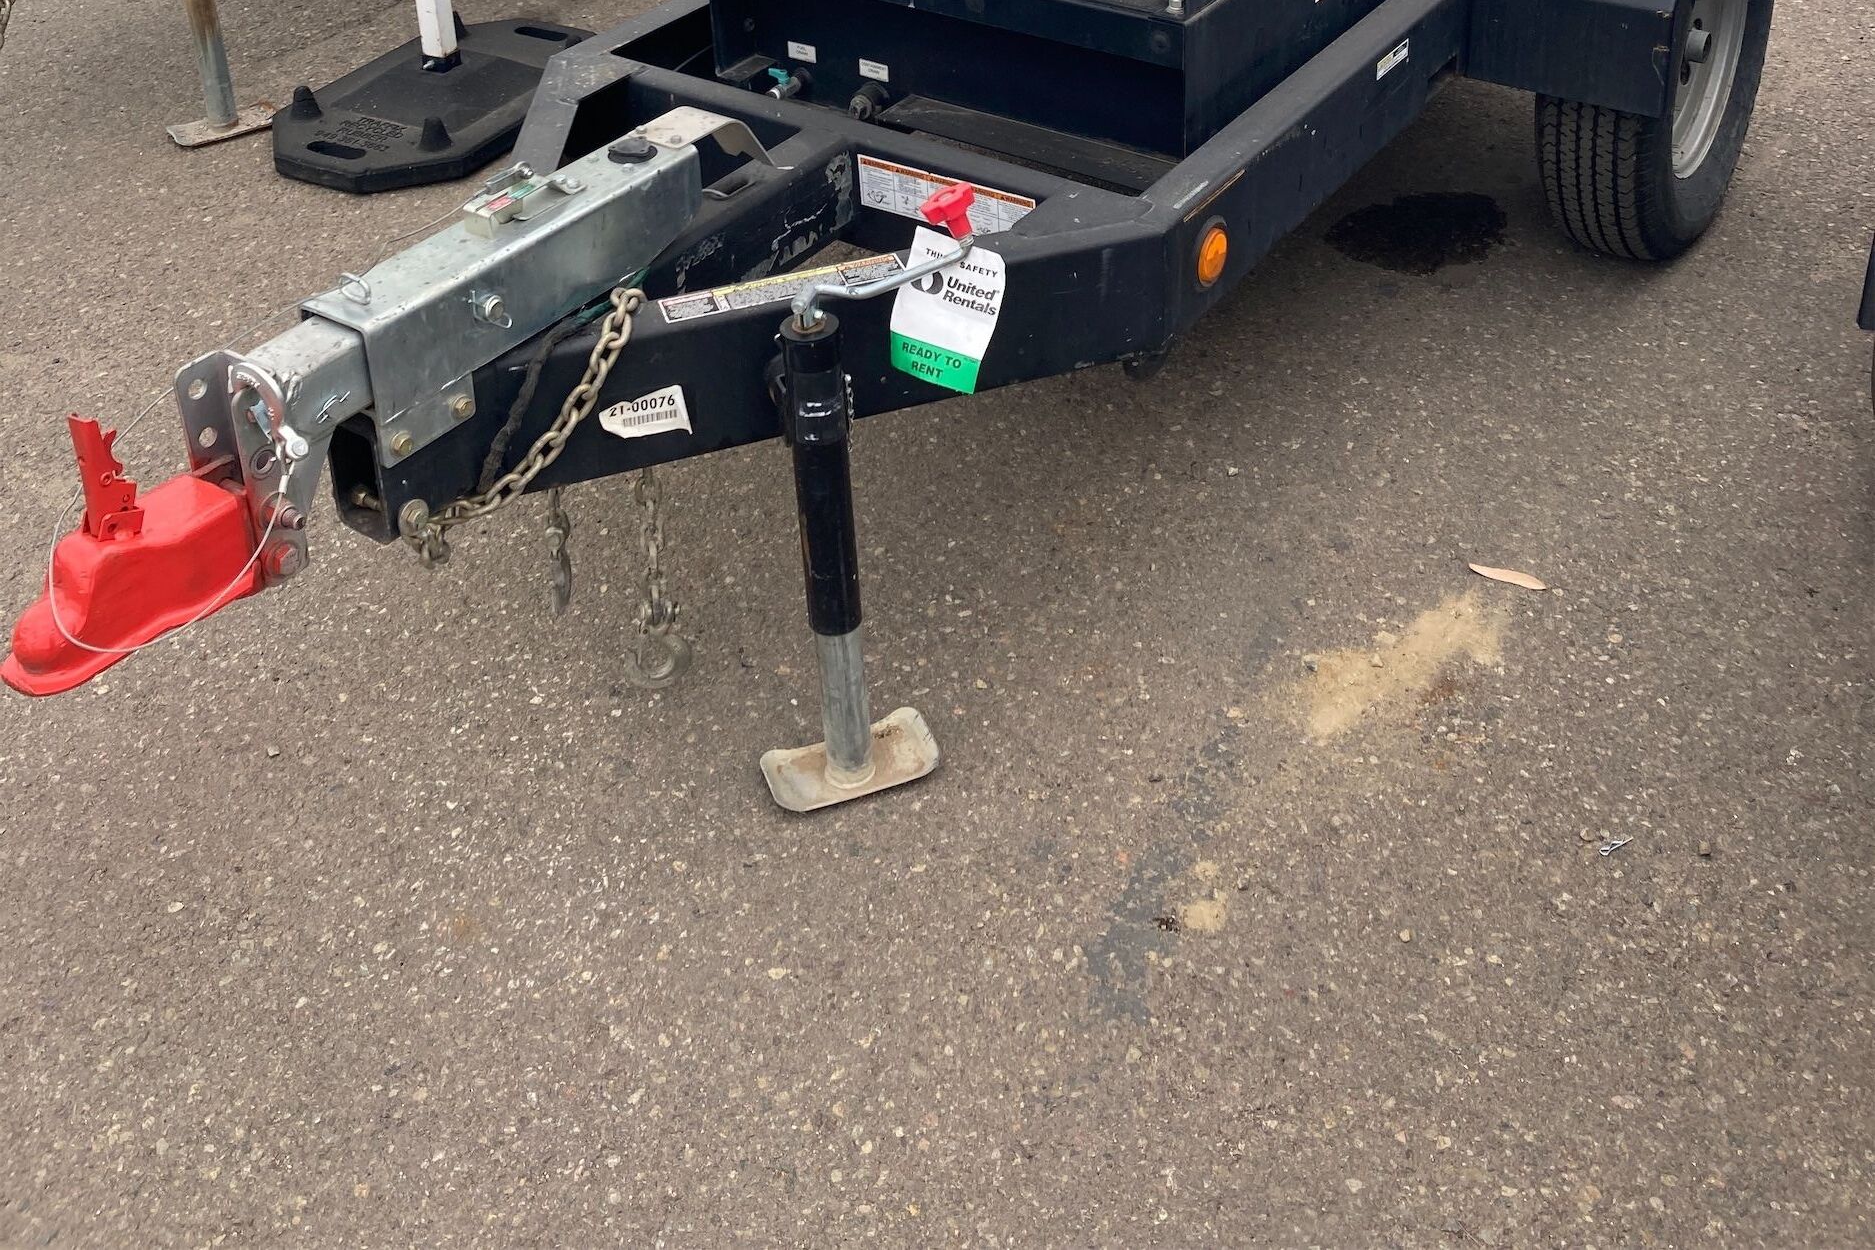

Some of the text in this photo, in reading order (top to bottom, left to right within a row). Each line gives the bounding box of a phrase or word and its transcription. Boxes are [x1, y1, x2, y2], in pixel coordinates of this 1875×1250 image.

[959, 261, 999, 278] SAFETY
[947, 276, 998, 301] United
[942, 289, 997, 316] Rentals
[902, 341, 962, 369] READY TO
[911, 361, 944, 378] RENT
[609, 394, 675, 418] 21-00076
